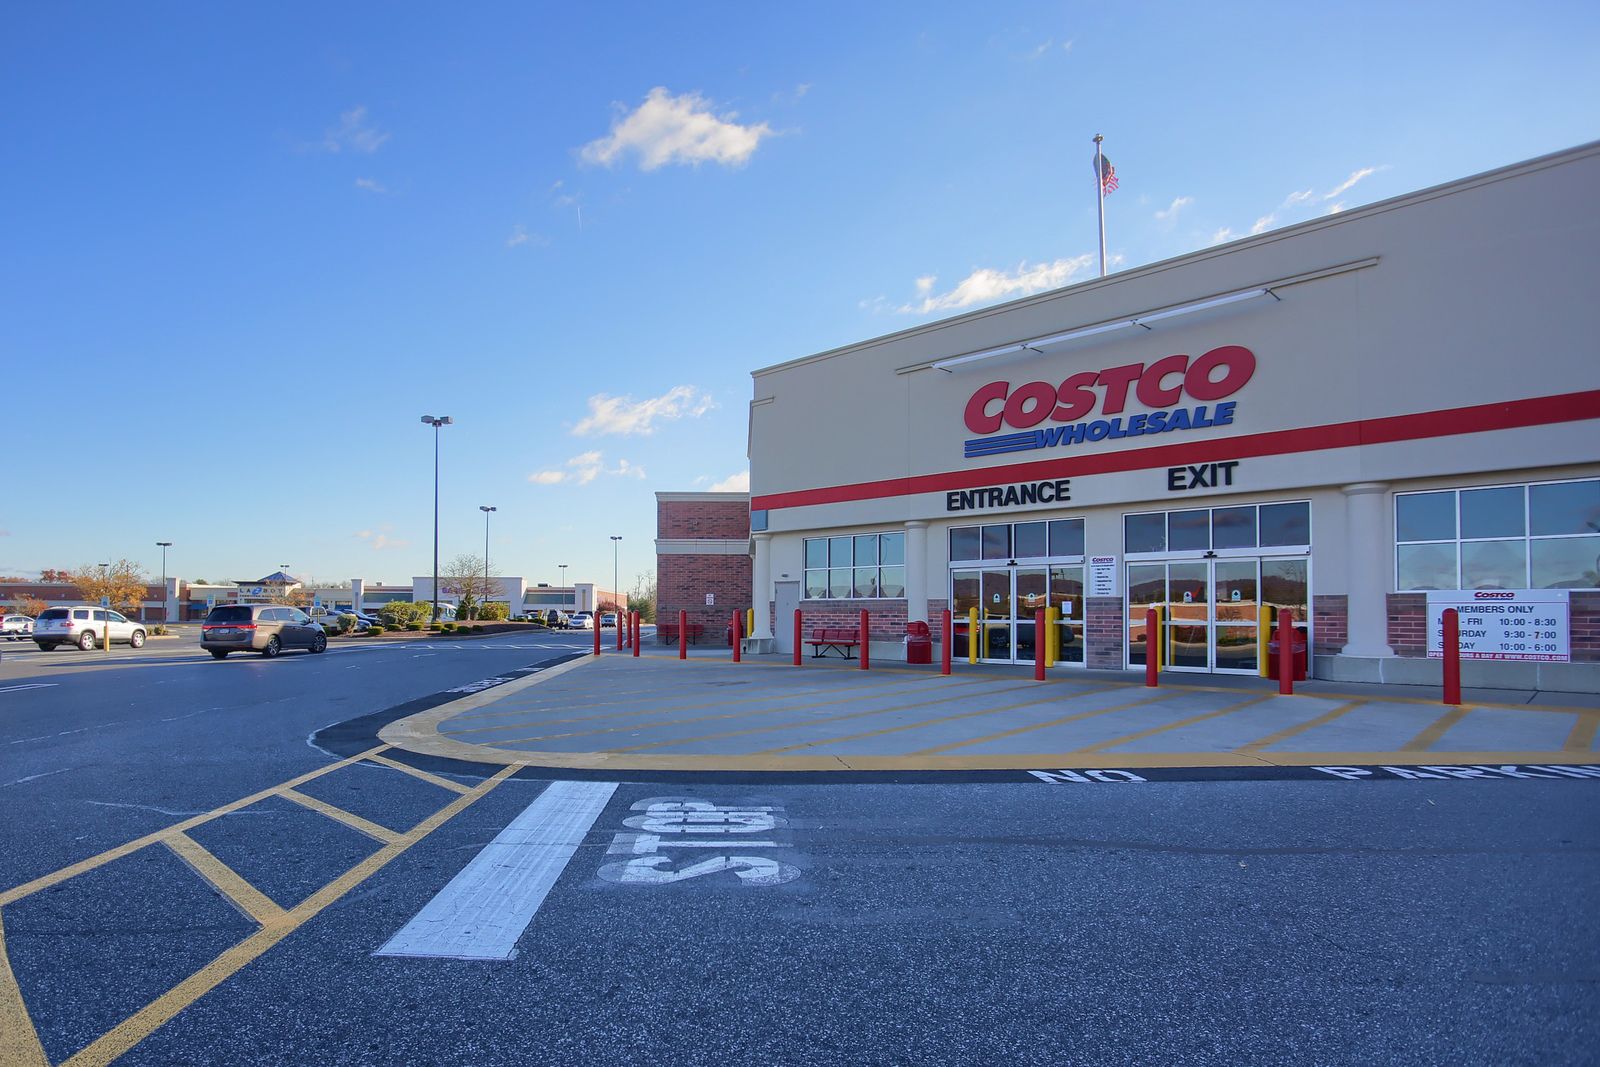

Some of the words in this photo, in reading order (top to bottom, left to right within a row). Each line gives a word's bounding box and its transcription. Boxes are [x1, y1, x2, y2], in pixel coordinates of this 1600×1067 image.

[964, 345, 1256, 435] COSTCO
[1035, 400, 1237, 448] WHOLESALE
[1167, 461, 1239, 491] EXIT
[946, 479, 1071, 511] ENTRANCE
[1457, 605, 1505, 613] MEMBERS
[1507, 605, 1535, 613] ONLY
[1467, 617, 1483, 625] FRI
[1499, 618, 1526, 626] 10:00
[1534, 618, 1557, 626] 8:30
[1437, 629, 1487, 638] SRDAY
[1503, 630, 1526, 638] 9:30
[1534, 631, 1557, 639] 7:00
[1437, 641, 1476, 649] SDAY
[1499, 642, 1526, 651] 10:00
[1534, 643, 1557, 652] 6:00
[1026, 769, 1148, 785] NO
[1310, 764, 1600, 780] PARKIN
[598, 797, 800, 887] STOP
